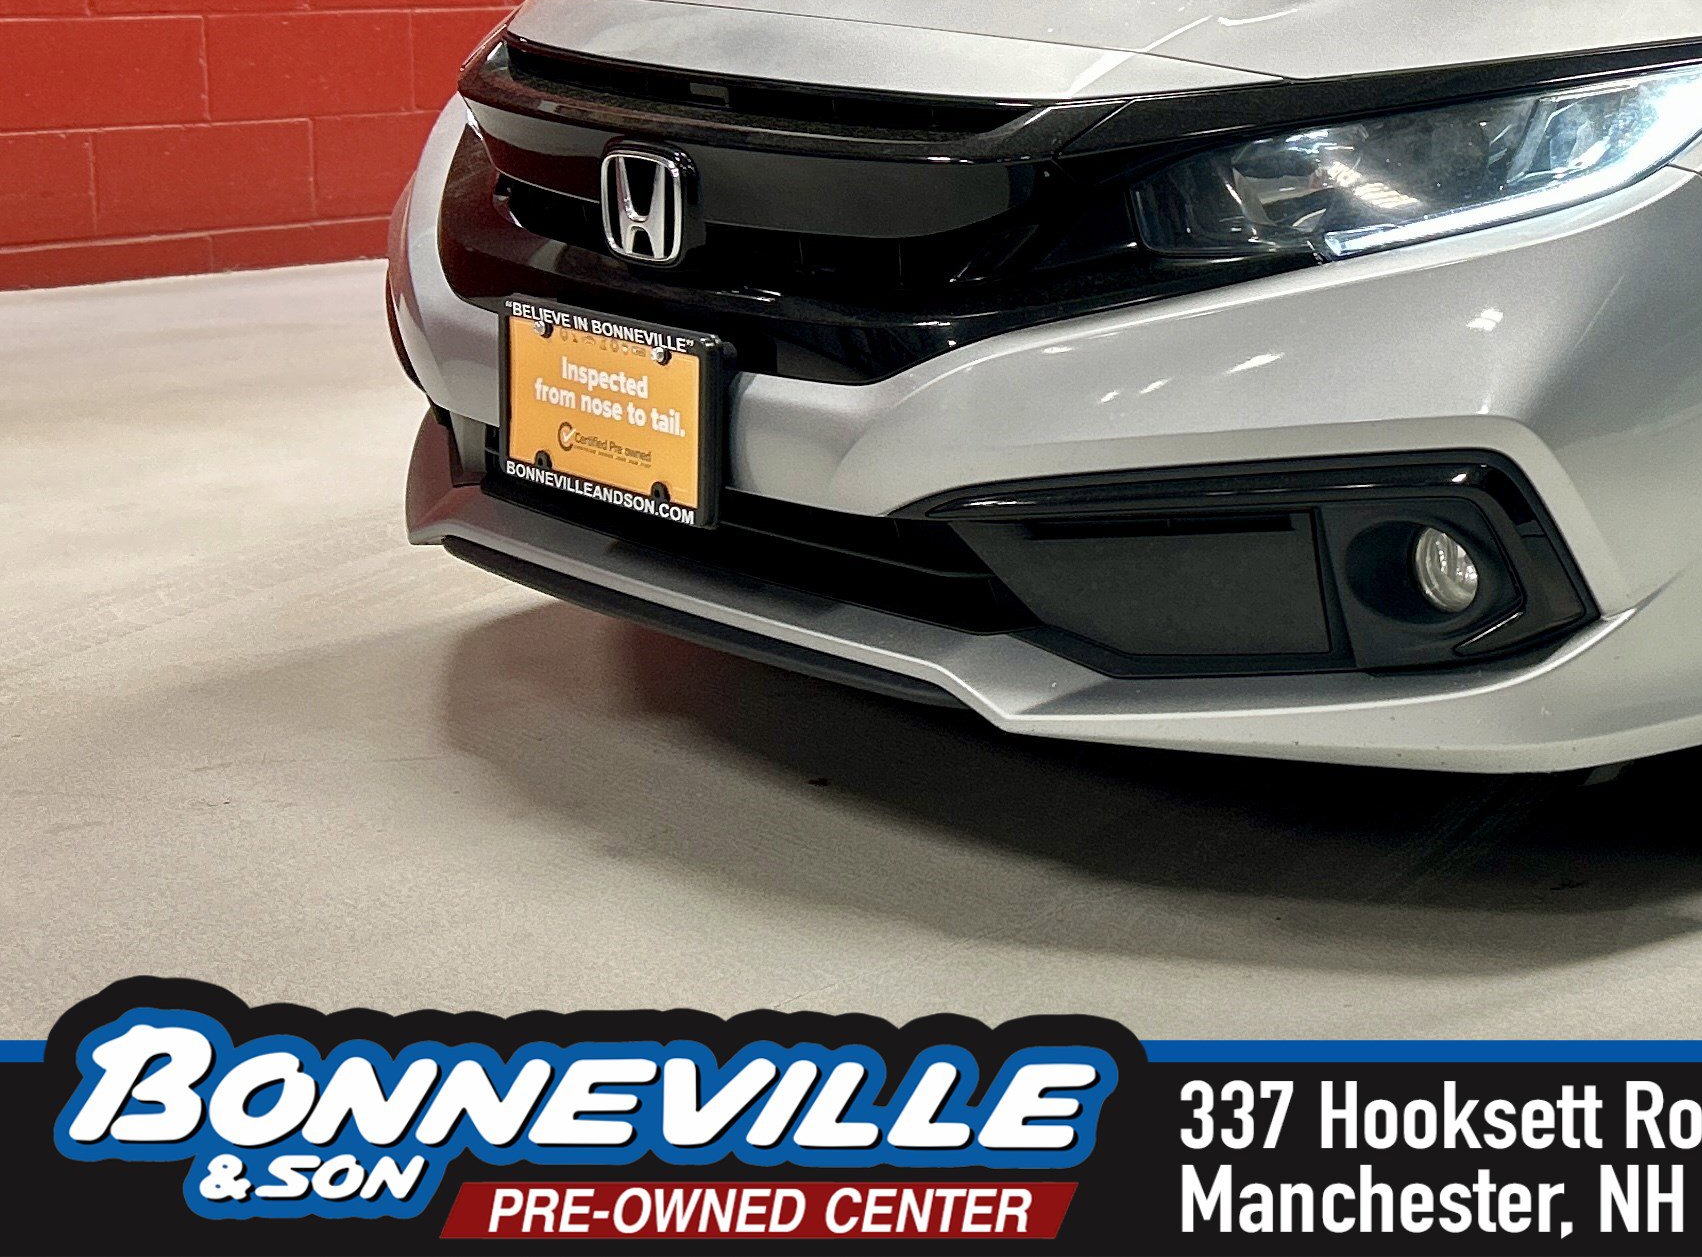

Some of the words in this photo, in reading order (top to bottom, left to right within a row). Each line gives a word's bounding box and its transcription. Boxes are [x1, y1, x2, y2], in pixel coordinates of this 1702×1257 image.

[573, 315, 589, 332] IN
[561, 355, 648, 399] Inspected
[534, 377, 576, 409] from
[580, 393, 623, 421] nose
[626, 401, 647, 427] to
[650, 407, 686, 437] tail.
[506, 460, 695, 525] BONNEVILLEANDSON.COM
